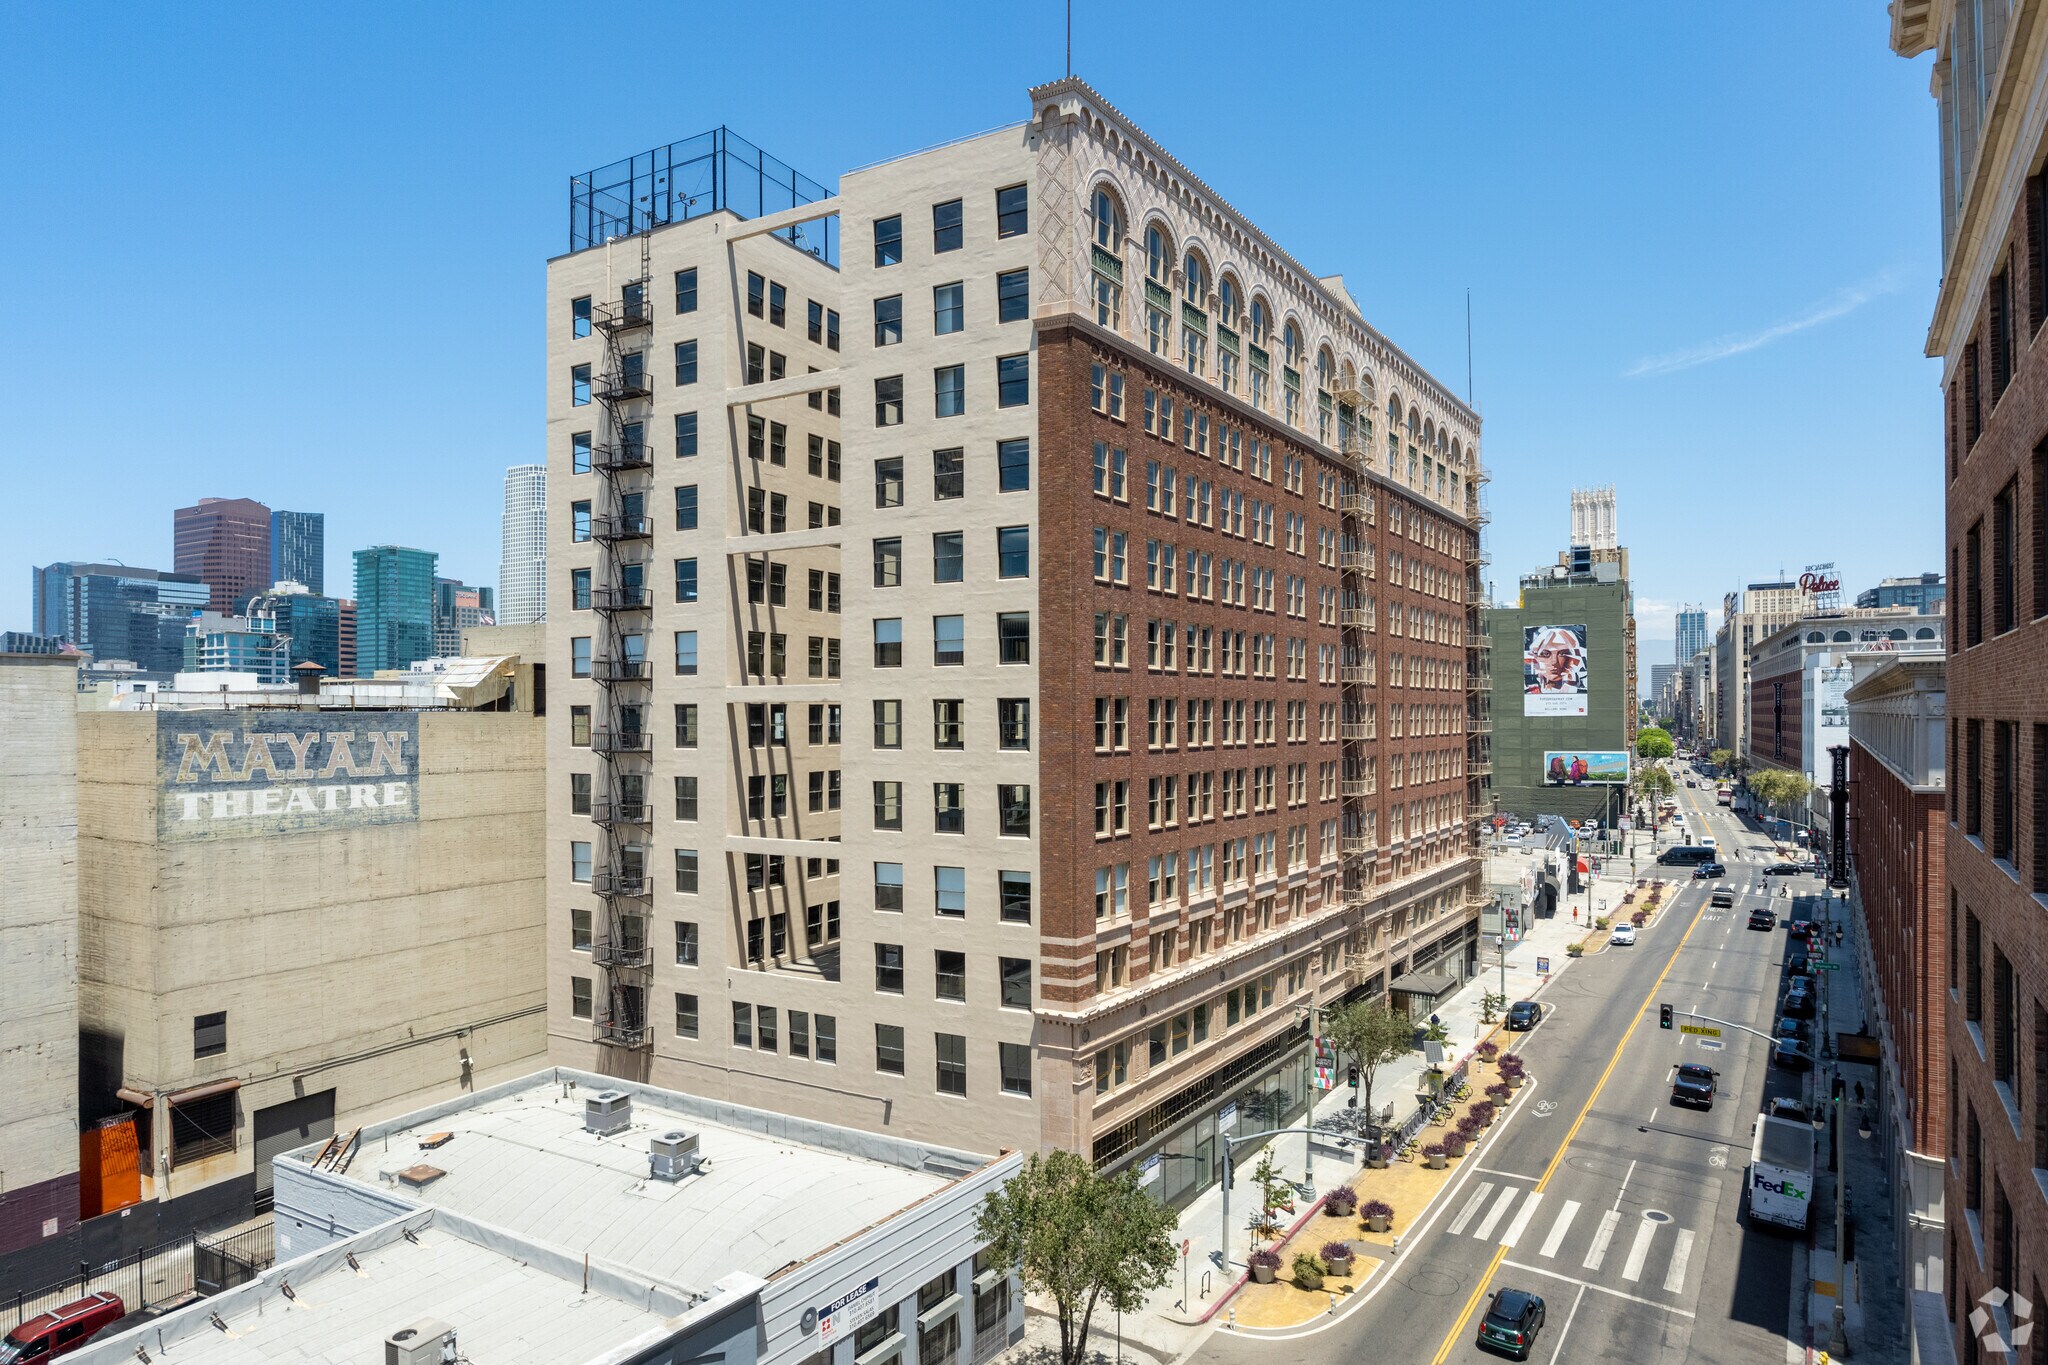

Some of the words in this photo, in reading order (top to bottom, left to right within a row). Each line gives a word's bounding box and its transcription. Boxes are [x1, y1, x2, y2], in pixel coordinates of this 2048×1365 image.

[1799, 572, 1840, 596] Palace
[176, 731, 408, 784] MAYAN
[1836, 748, 1844, 791] BROADWAY
[175, 781, 408, 821] THEATRE
[1754, 1174, 1806, 1200] FedEx
[831, 1297, 845, 1312] FOR
[846, 1284, 867, 1303] LEASE
